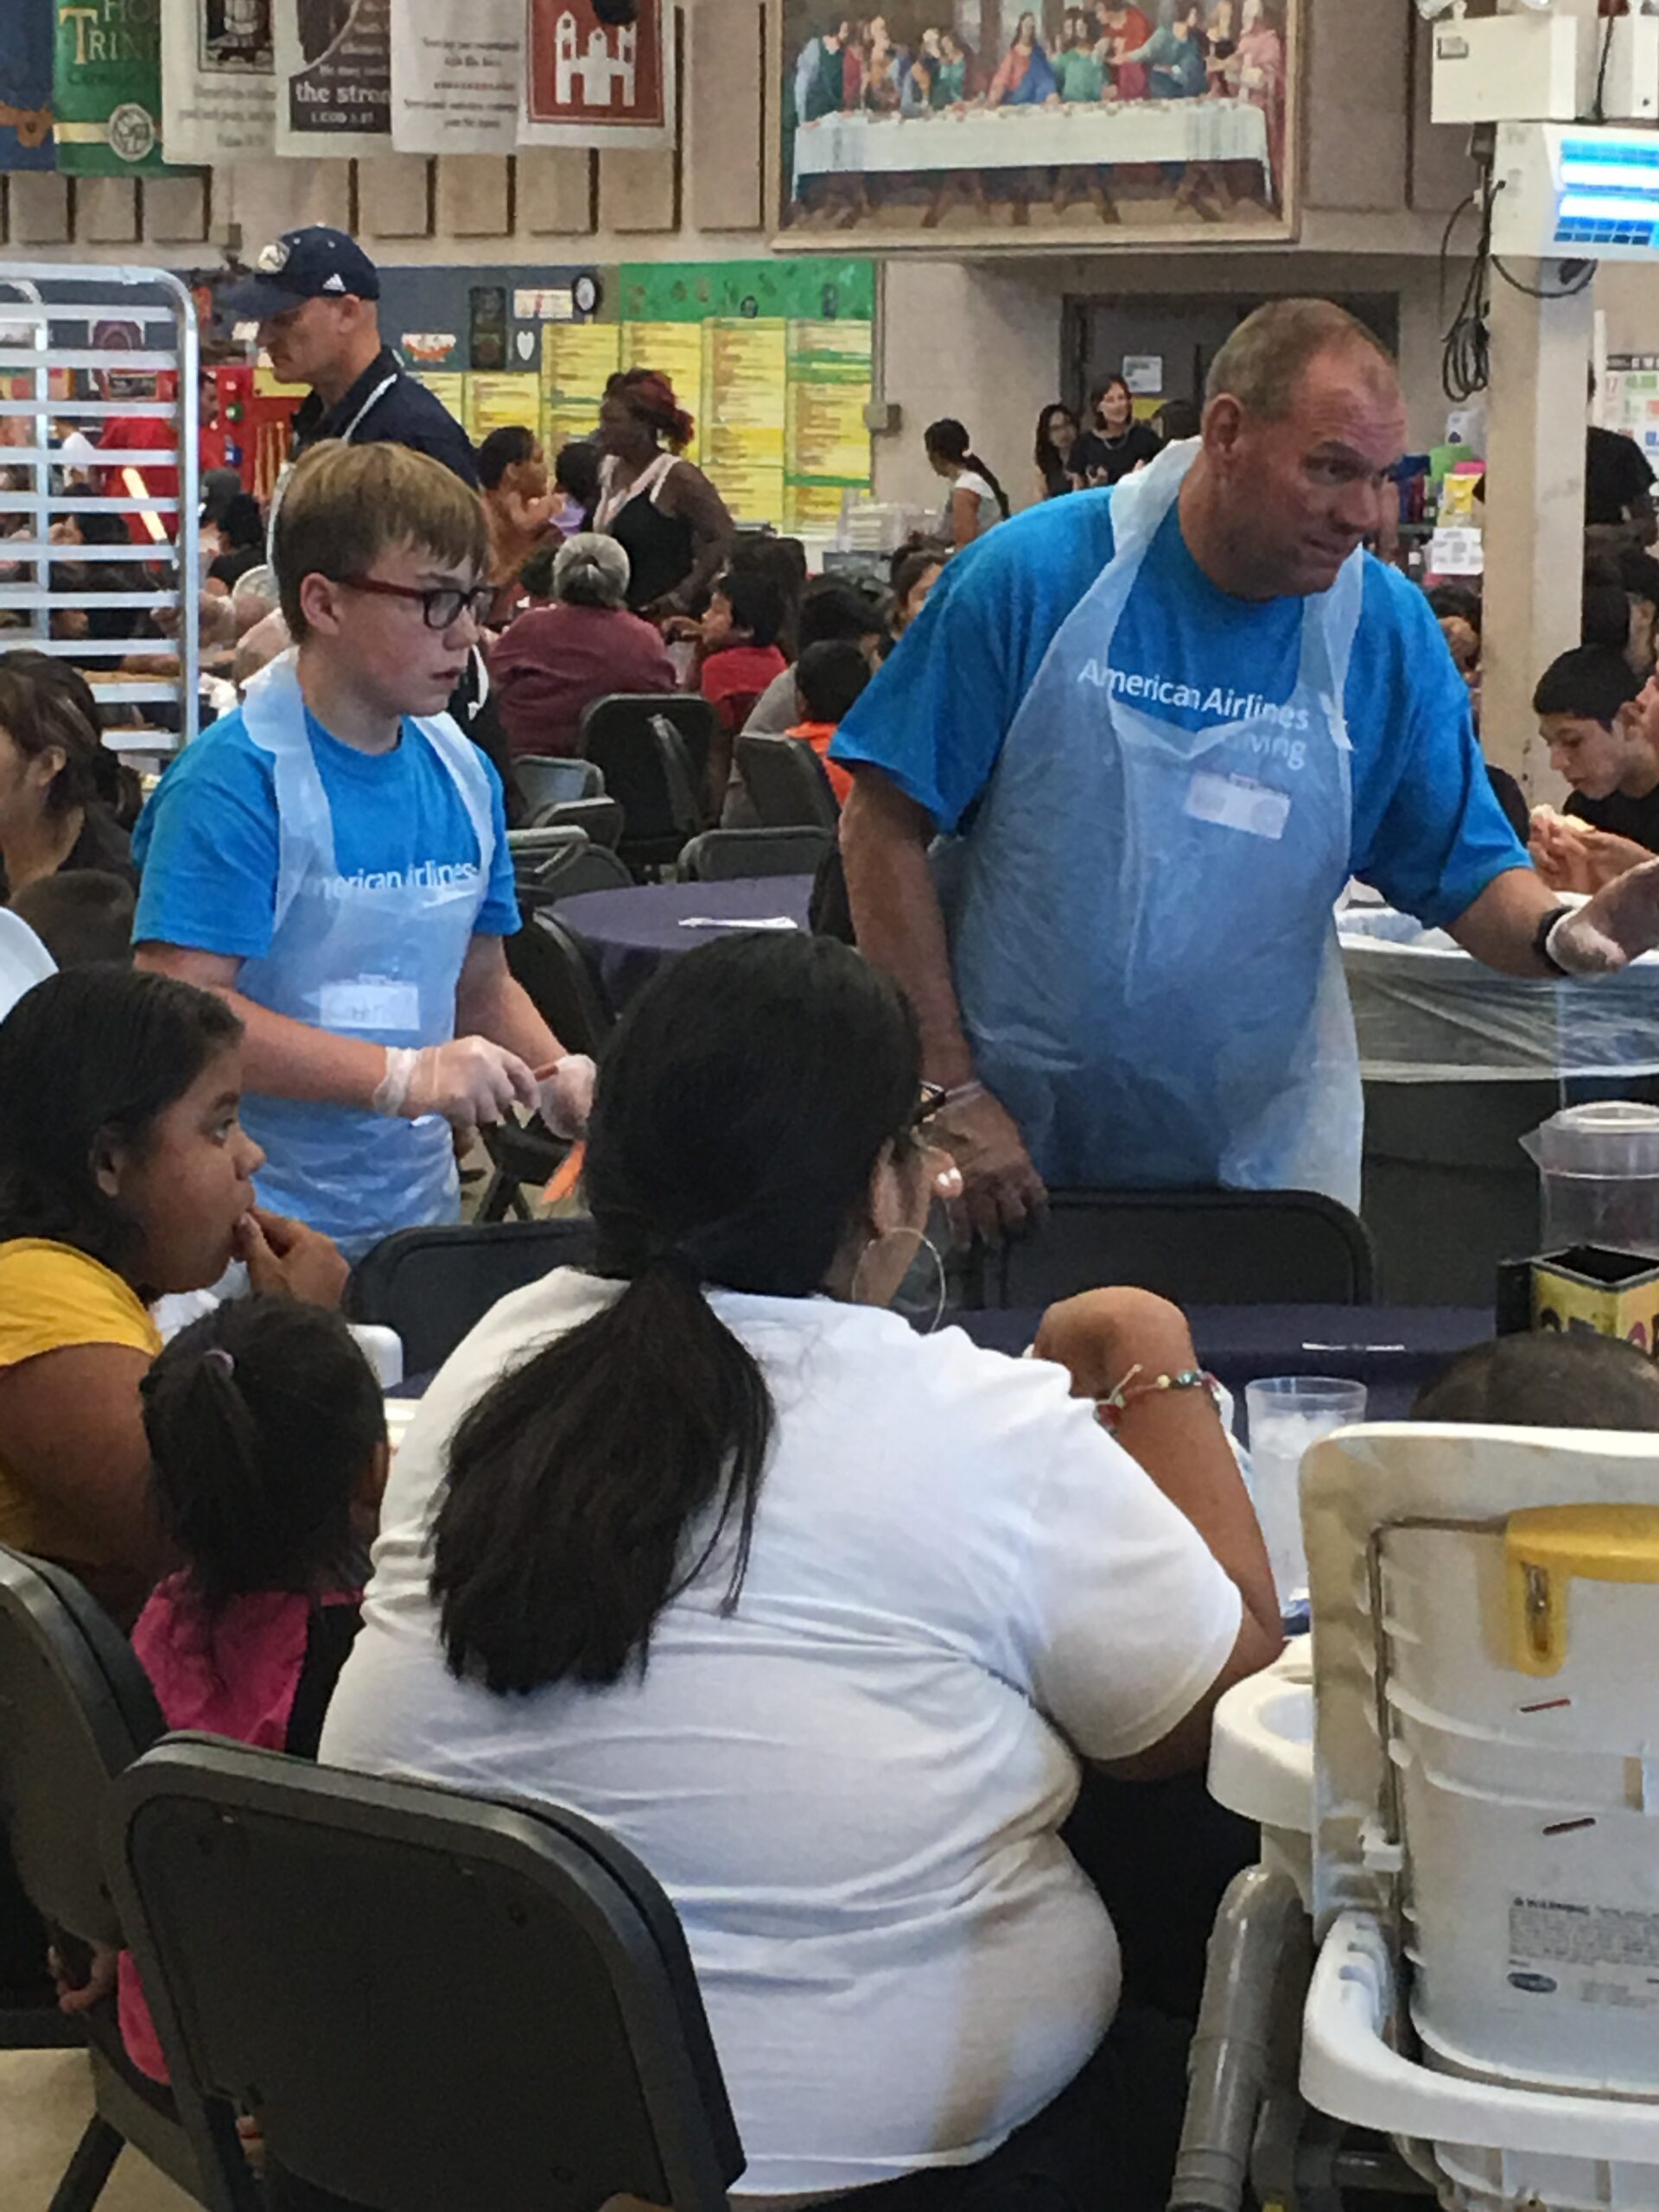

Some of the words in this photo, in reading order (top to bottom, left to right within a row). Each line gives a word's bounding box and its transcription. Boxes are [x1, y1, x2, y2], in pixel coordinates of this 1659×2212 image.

[296, 80, 330, 103] the
[1077, 658, 1201, 709] American
[1200, 687, 1309, 730] Airlines
